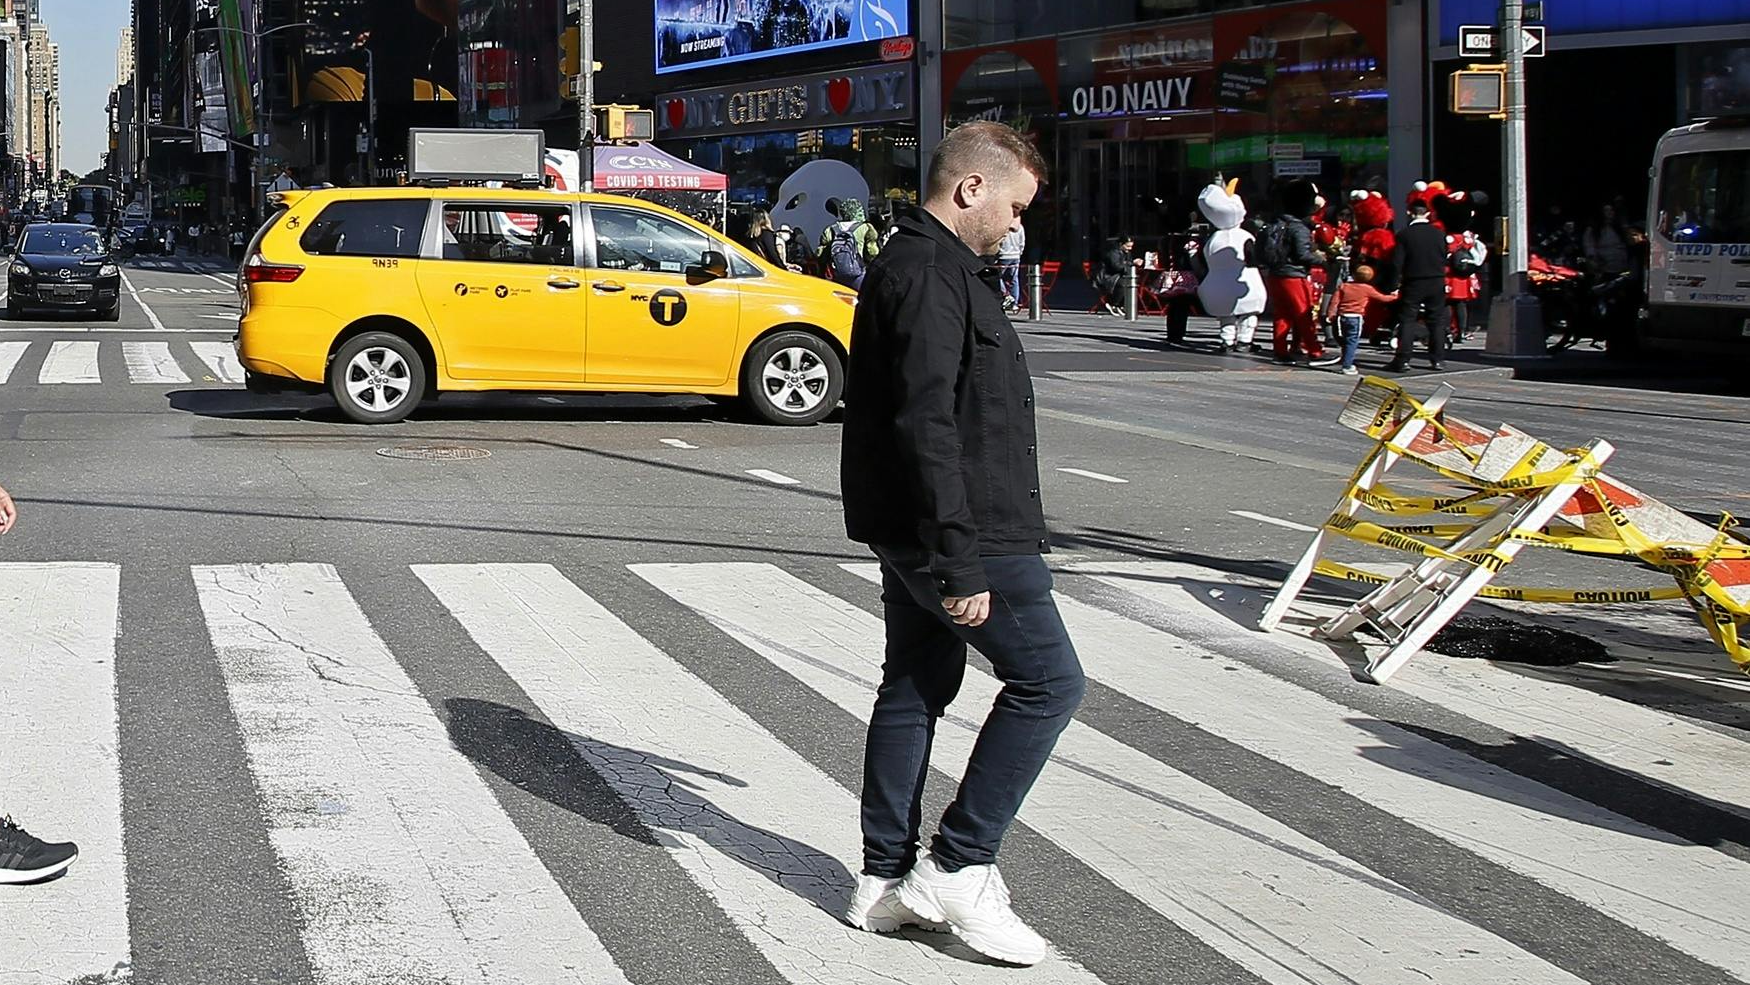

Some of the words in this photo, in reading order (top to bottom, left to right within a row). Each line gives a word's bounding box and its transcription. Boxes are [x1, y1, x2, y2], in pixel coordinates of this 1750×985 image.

[680, 43, 693, 54] NOW
[693, 35, 725, 52] STREAMING
[728, 85, 808, 125] GIFTS
[1072, 84, 1118, 116] OLD
[1123, 76, 1192, 114] NAVY
[606, 175, 655, 188] COVID-19
[658, 175, 701, 189] TESTING
[1674, 243, 1713, 256] NYPD
[372, 258, 399, 268] 9N39
[657, 295, 680, 322] T
